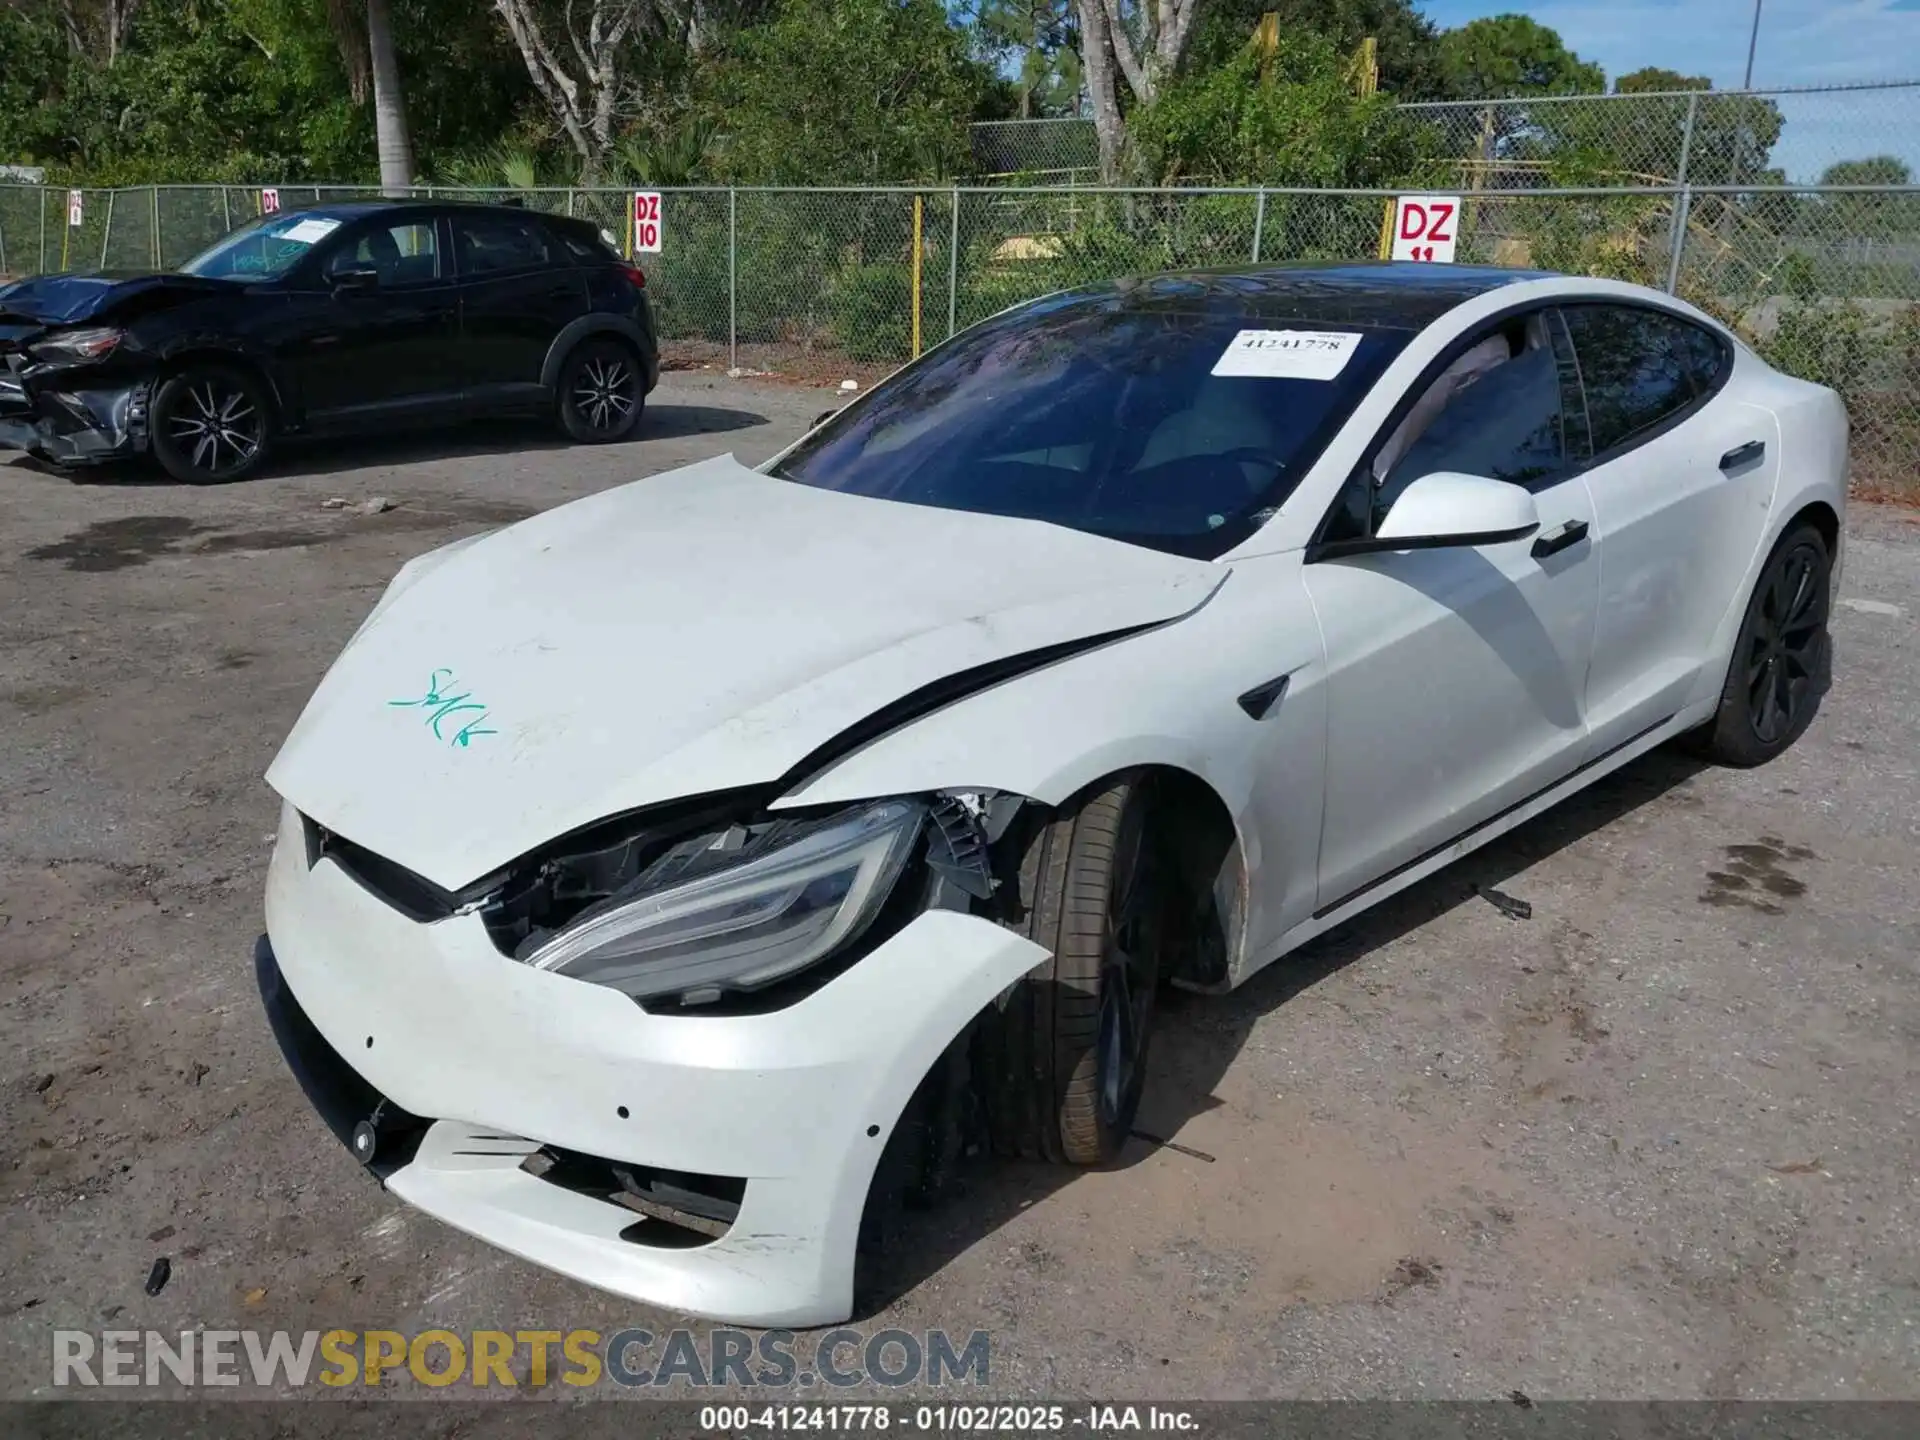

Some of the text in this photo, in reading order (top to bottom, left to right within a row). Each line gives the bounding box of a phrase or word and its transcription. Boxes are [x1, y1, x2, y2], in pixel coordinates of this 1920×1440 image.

[637, 196, 658, 220] DZ
[1401, 204, 1453, 241] DZ
[640, 223, 656, 247] 10
[1242, 339, 1340, 350] 41241778
